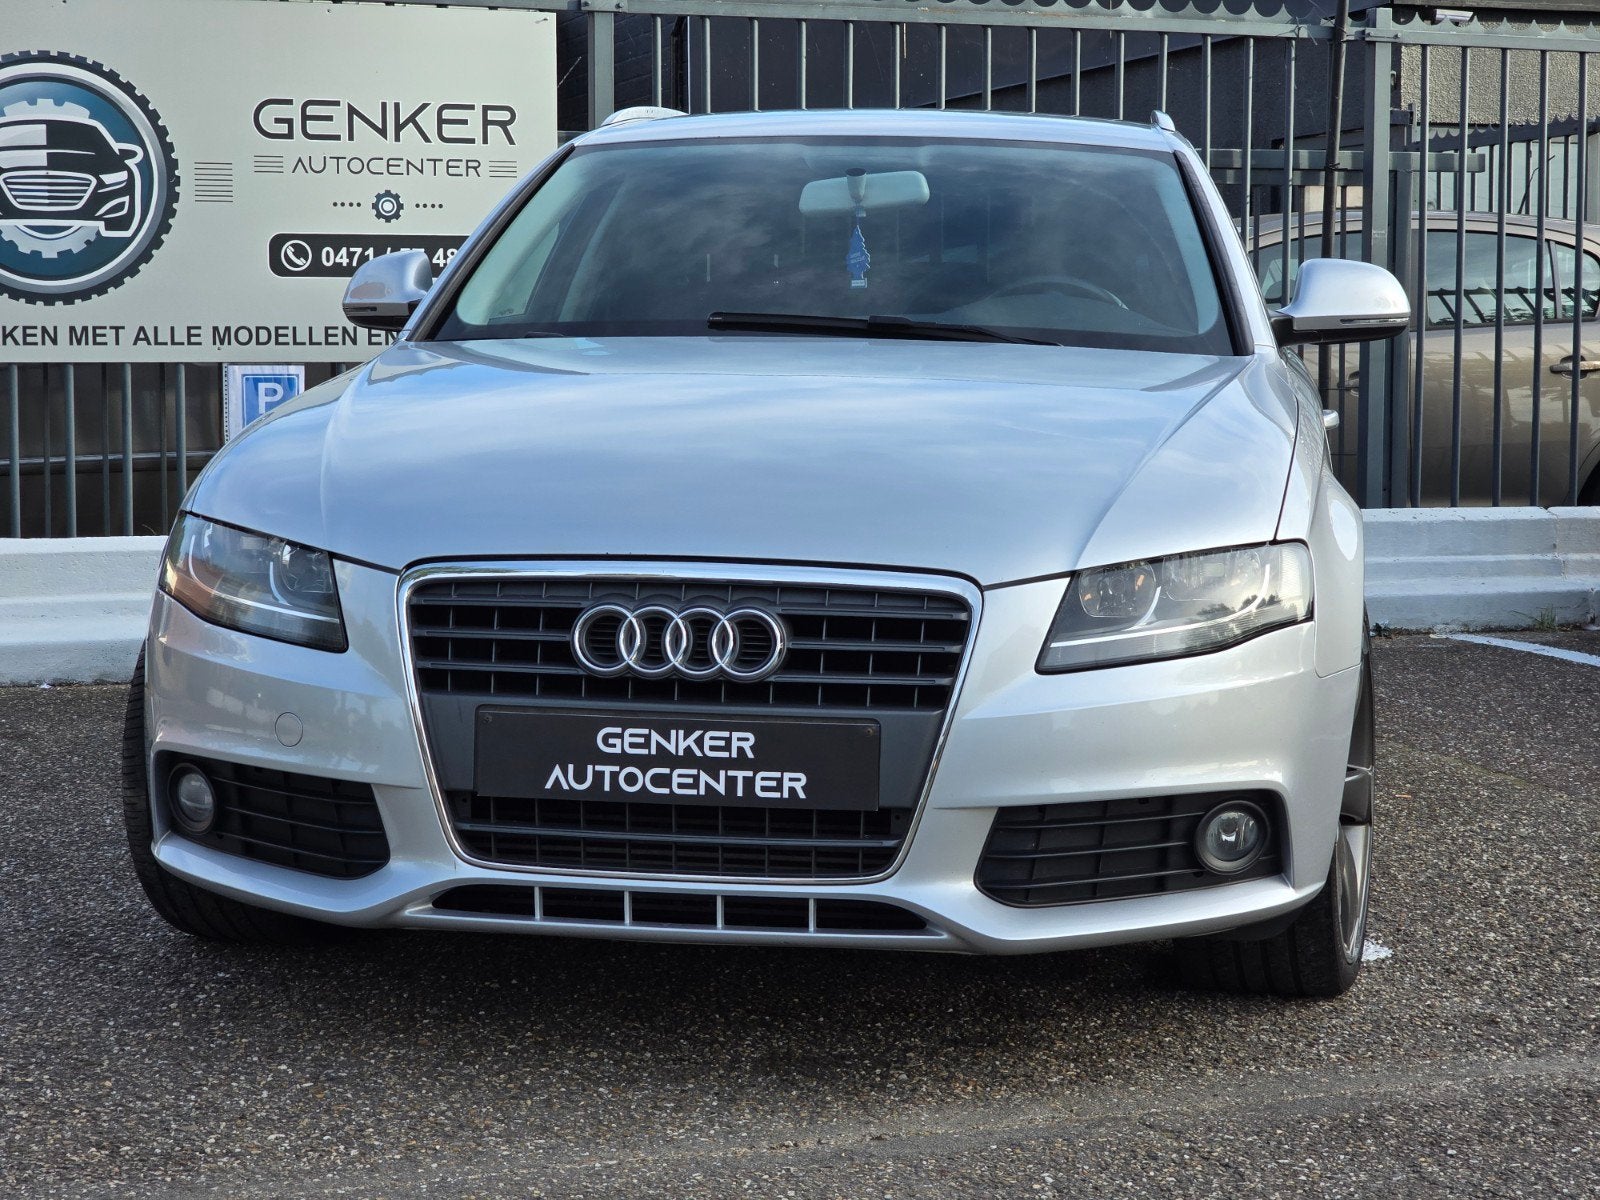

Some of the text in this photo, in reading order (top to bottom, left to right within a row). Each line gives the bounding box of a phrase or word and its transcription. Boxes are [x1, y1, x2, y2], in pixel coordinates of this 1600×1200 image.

[253, 98, 517, 146] GENKER
[291, 155, 482, 178] AUTOCENTER
[321, 247, 374, 267] 0471
[1, 325, 59, 346] KEN
[68, 325, 126, 346] MET
[132, 325, 203, 346] ALLE
[212, 325, 358, 346] MODELLEN
[257, 382, 284, 415] P
[596, 726, 755, 759] GENKER
[544, 763, 808, 800] AUTOCENTER
